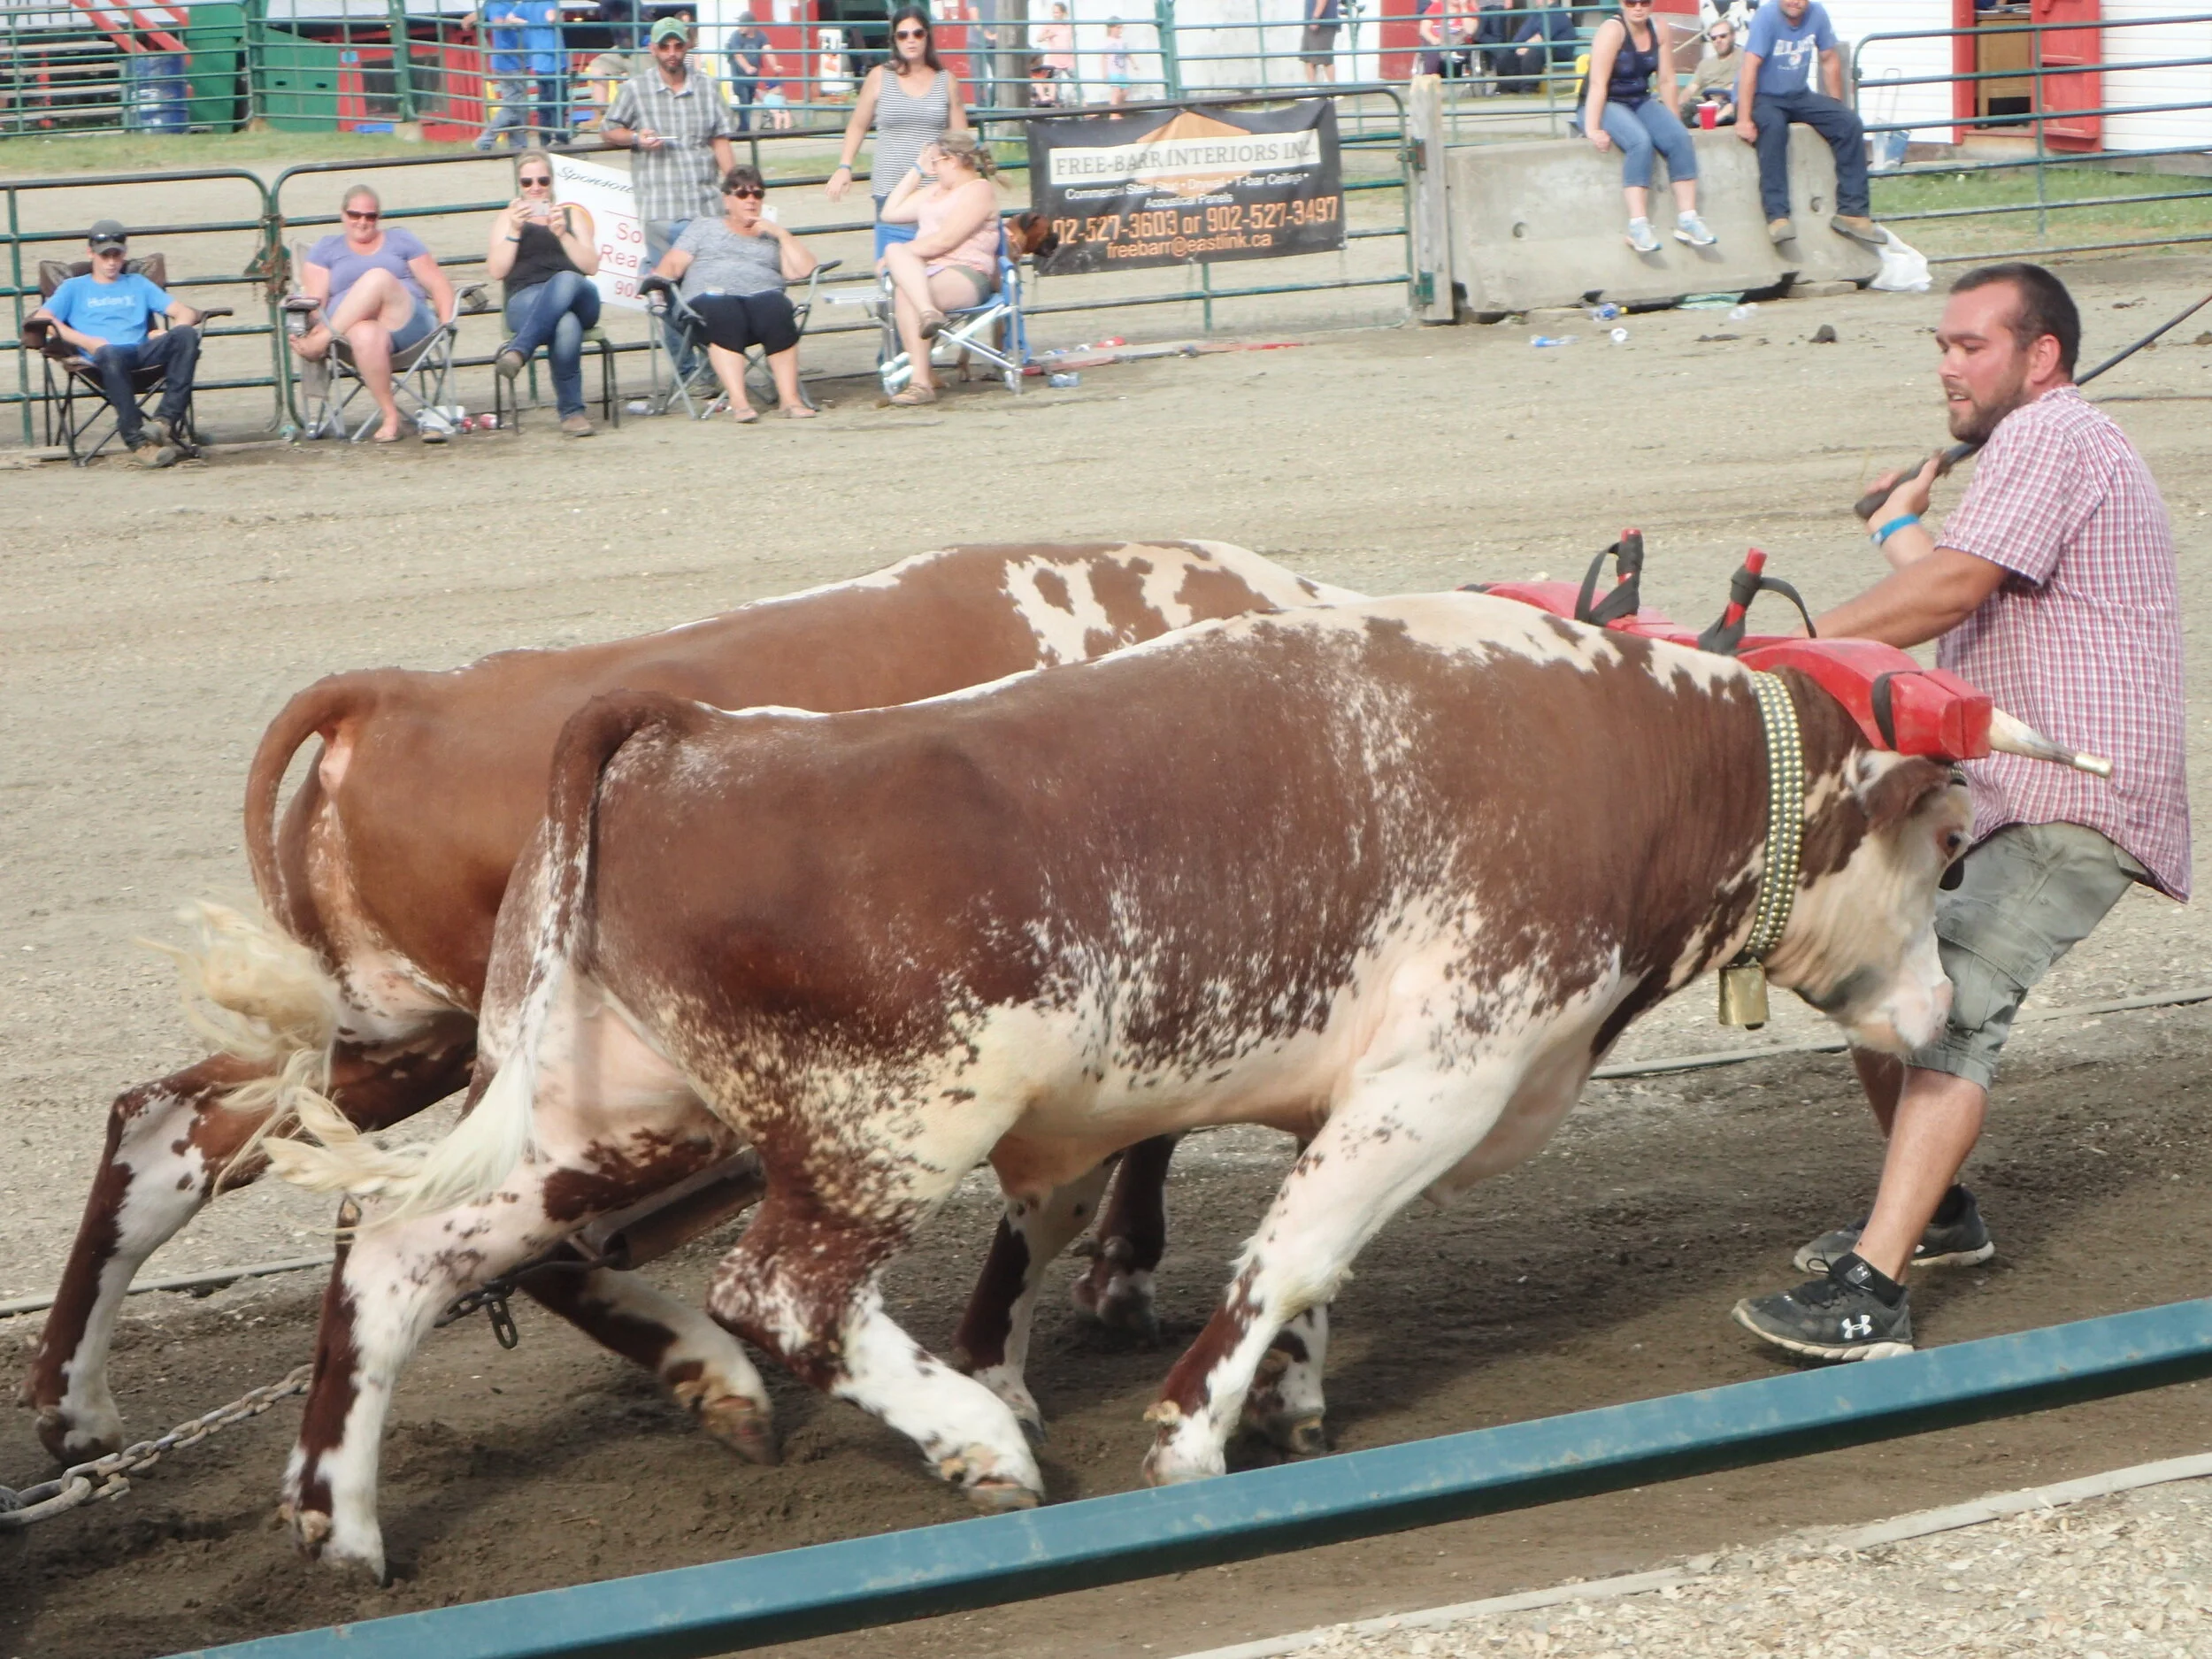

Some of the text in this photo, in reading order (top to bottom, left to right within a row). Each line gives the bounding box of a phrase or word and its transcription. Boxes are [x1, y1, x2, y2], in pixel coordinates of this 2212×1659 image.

[1056, 150, 1163, 176] FREE-BARR
[1167, 142, 1279, 167] INTERIORS
[1125, 183, 1154, 195] Steel
[1235, 175, 1265, 187] T-bar
[1144, 191, 1233, 208] Acoustical Panels
[1182, 216, 1202, 234] or
[1206, 196, 1338, 232] 902-527-3497
[1107, 232, 1272, 258] freebarr@eastlink.ca
